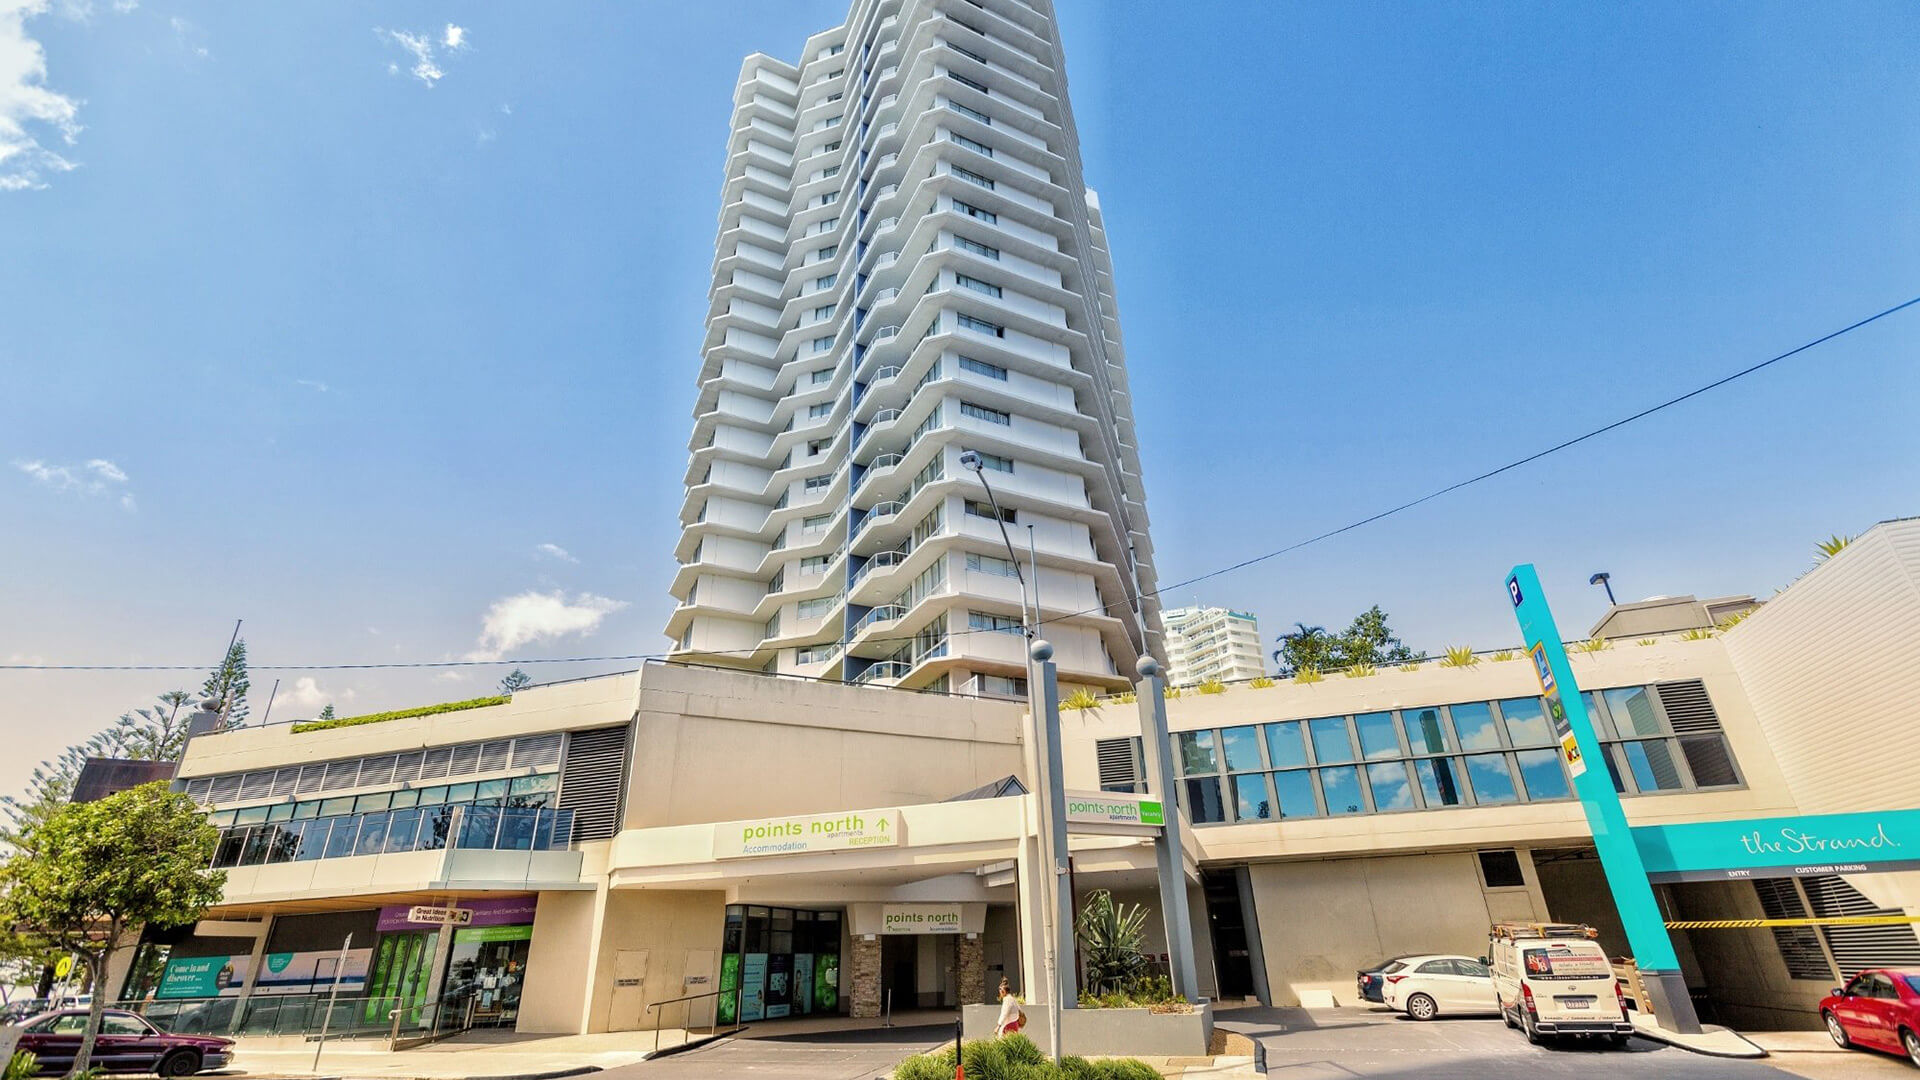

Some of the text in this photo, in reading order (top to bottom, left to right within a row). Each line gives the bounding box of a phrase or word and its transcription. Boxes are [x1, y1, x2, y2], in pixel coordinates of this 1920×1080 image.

[1069, 801, 1137, 815] points north
[743, 815, 864, 843] points north
[827, 829, 864, 839] apartments
[849, 835, 890, 846] RECEPTION
[743, 841, 808, 854] Accommodation
[1728, 870, 1750, 878] ENTRY
[1795, 864, 1867, 874] CUSTOMER PARKING
[416, 907, 433, 915] Great
[422, 914, 445, 922] Nutrition
[886, 912, 959, 925] points north
